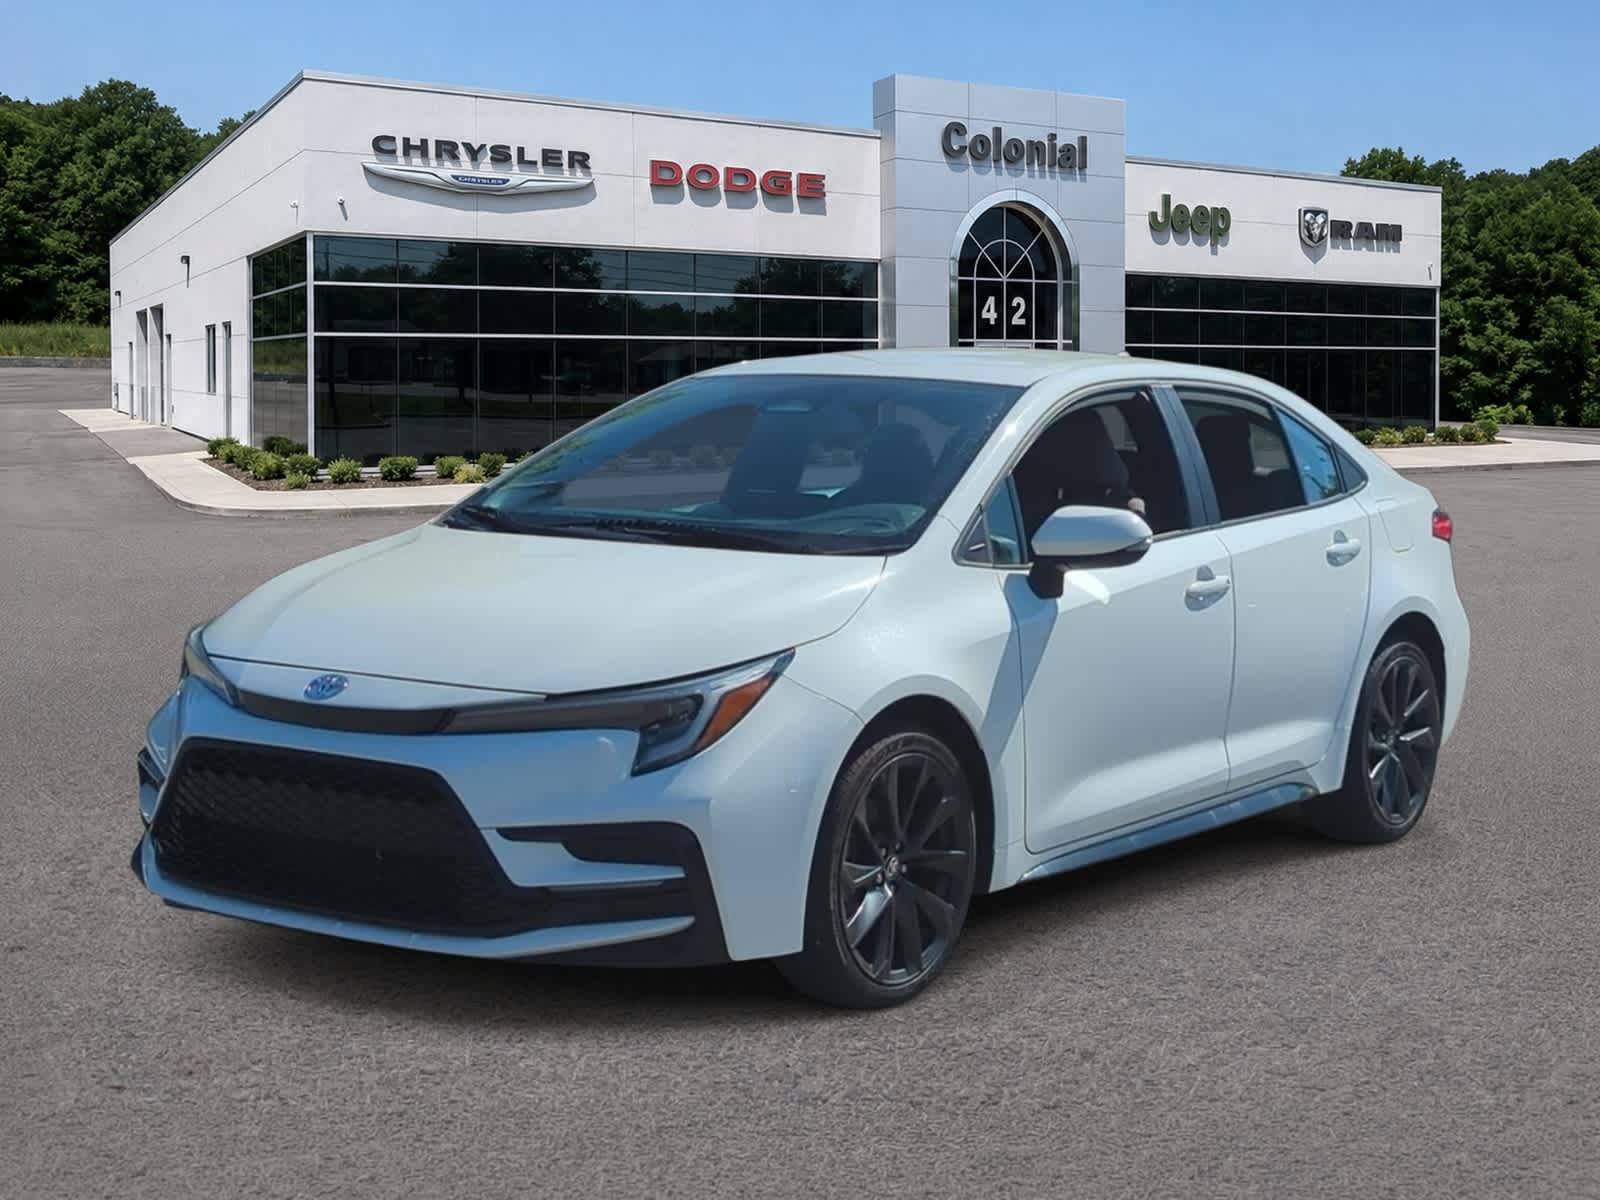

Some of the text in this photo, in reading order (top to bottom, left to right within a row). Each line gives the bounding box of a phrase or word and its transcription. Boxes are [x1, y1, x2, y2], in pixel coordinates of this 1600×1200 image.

[371, 135, 591, 170] CHRYSLER
[942, 121, 1088, 169] Colonial
[650, 159, 826, 198] DODGE
[1149, 194, 1231, 244] Jeep
[1330, 219, 1402, 242] RAM
